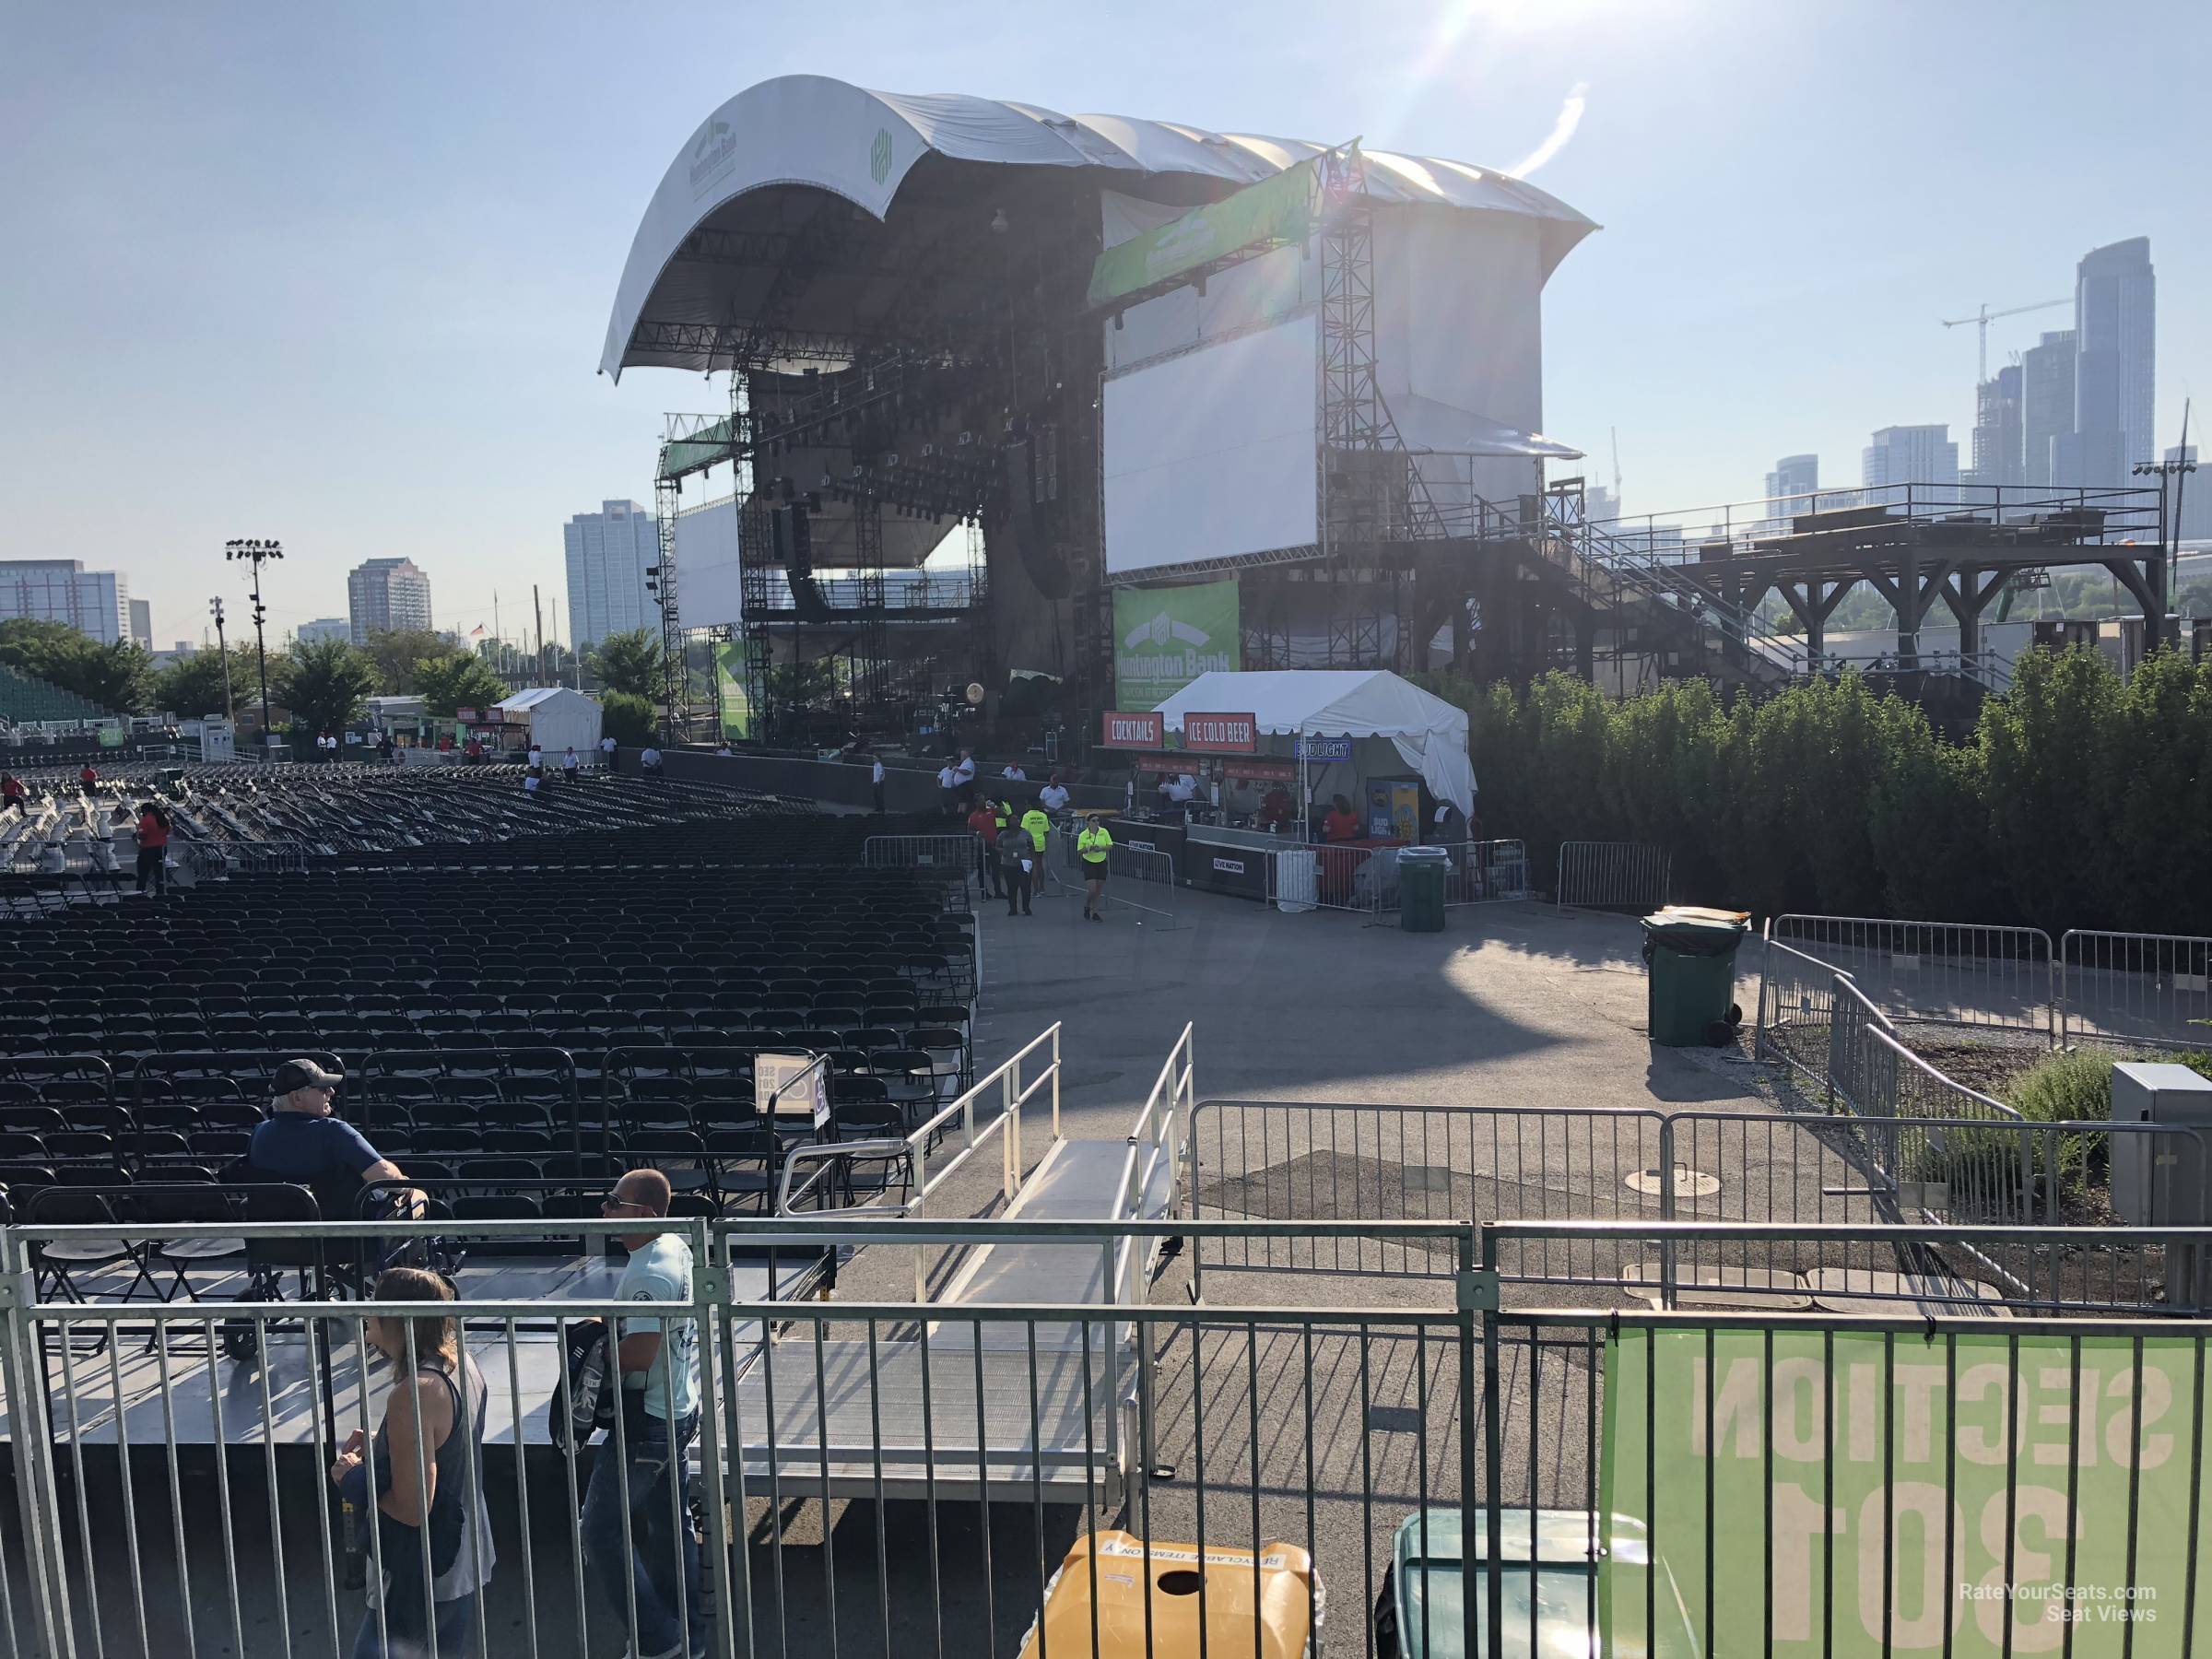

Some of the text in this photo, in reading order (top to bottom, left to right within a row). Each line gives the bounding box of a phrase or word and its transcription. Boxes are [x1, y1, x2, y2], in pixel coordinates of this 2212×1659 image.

[1112, 720, 1154, 742] COCKTAILS
[1188, 722, 1251, 743] ICE COLD BEER
[1318, 742, 1348, 757] LIGHT
[1105, 1544, 1141, 1556] ONY
